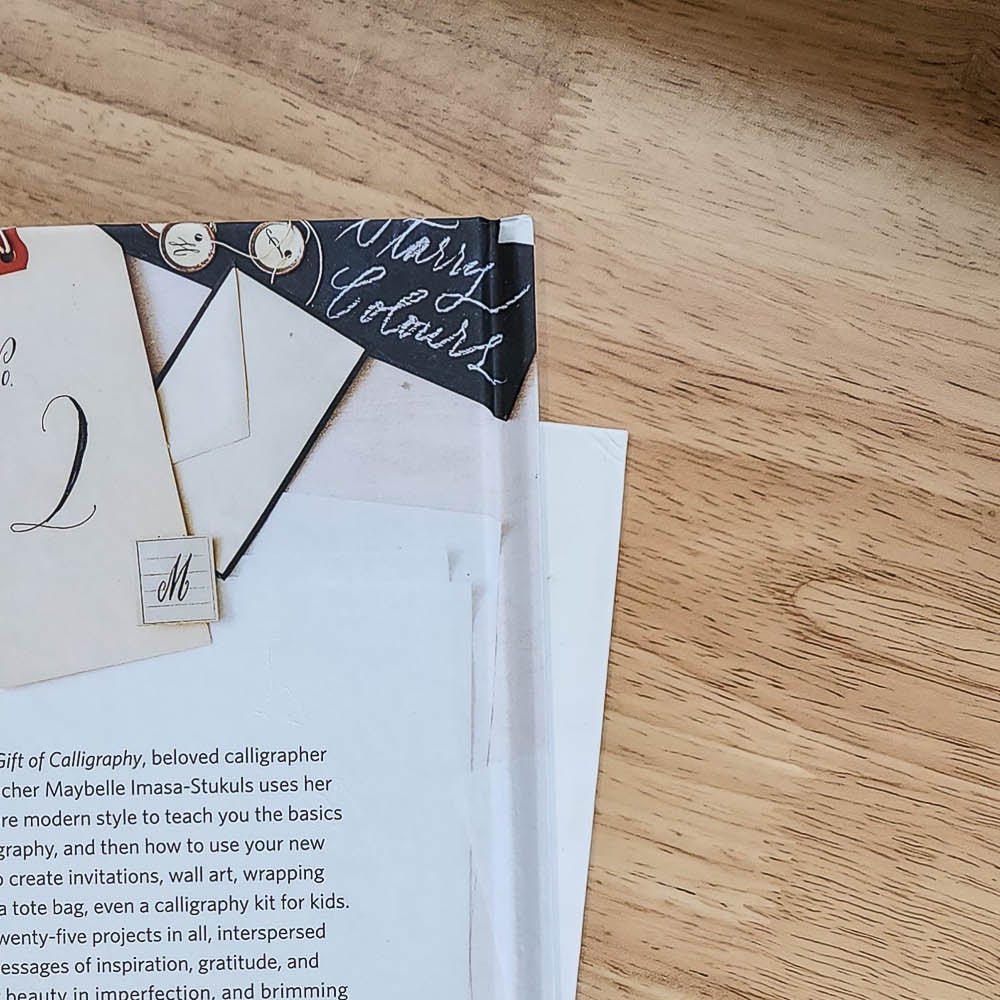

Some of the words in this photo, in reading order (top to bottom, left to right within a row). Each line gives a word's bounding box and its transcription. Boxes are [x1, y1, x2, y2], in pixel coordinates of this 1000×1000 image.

[10, 394, 96, 533] 2
[28, 751, 46, 772] of
[49, 749, 146, 771] Calligraphy,
[151, 747, 219, 766] beloved
[224, 745, 328, 767] calligrapher
[45, 779, 126, 801] Maybelle
[131, 776, 254, 796] Imasa-Stukuls
[259, 779, 299, 793] uses
[303, 774, 333, 792] her
[23, 809, 91, 828] modern
[96, 808, 138, 830] style
[141, 809, 160, 825] to
[164, 806, 213, 825] teach
[217, 810, 250, 827] you
[254, 805, 283, 823] the
[288, 804, 343, 822] basics
[63, 838, 96, 857] and
[99, 838, 140, 856] then
[144, 837, 182, 855] how
[186, 837, 205, 854] to
[209, 840, 240, 853] use
[244, 839, 284, 856] your
[289, 838, 326, 852] new
[9, 870, 64, 887] create
[68, 867, 164, 887] invitations,
[168, 865, 204, 884] wall
[208, 866, 238, 885] art,
[242, 864, 325, 885] wrapping
[11, 900, 48, 916] tote
[52, 898, 89, 919] bag,
[93, 901, 135, 915] even
[139, 901, 150, 914] a
[154, 894, 250, 916] calligraphy
[254, 893, 276, 911] kit
[280, 893, 305, 911] for
[310, 891, 350, 910] kids.
[92, 927, 162, 948] projects
[167, 926, 183, 943] in
[187, 924, 212, 944] all,
[217, 921, 326, 944] interspersed
[74, 956, 92, 974] of
[96, 955, 193, 977] inspiration,
[197, 952, 282, 975] gratitude,
[287, 951, 319, 970] and
[221, 982, 255, 1000] and
